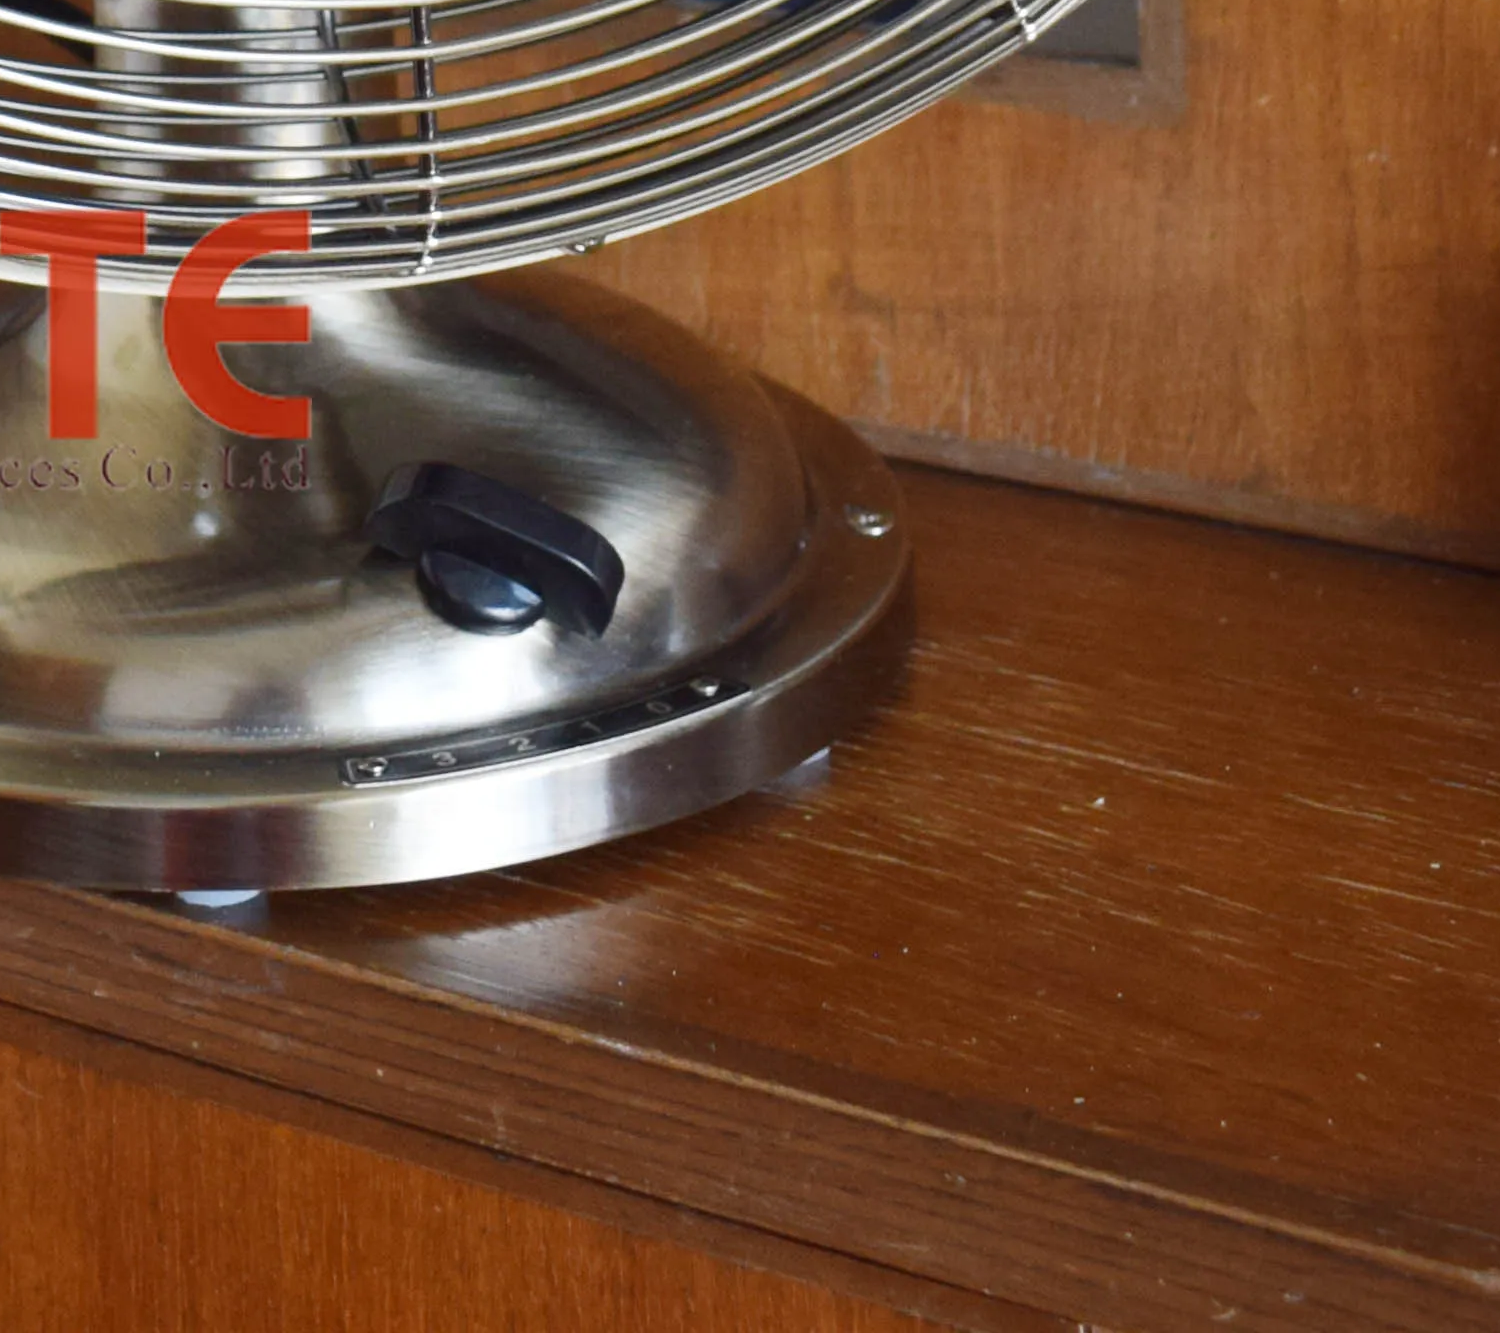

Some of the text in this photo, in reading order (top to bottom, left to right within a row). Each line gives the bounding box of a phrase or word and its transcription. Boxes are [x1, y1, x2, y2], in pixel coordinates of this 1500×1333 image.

[431, 751, 457, 767] 3
[508, 737, 537, 753] 2
[645, 701, 673, 714] 0
